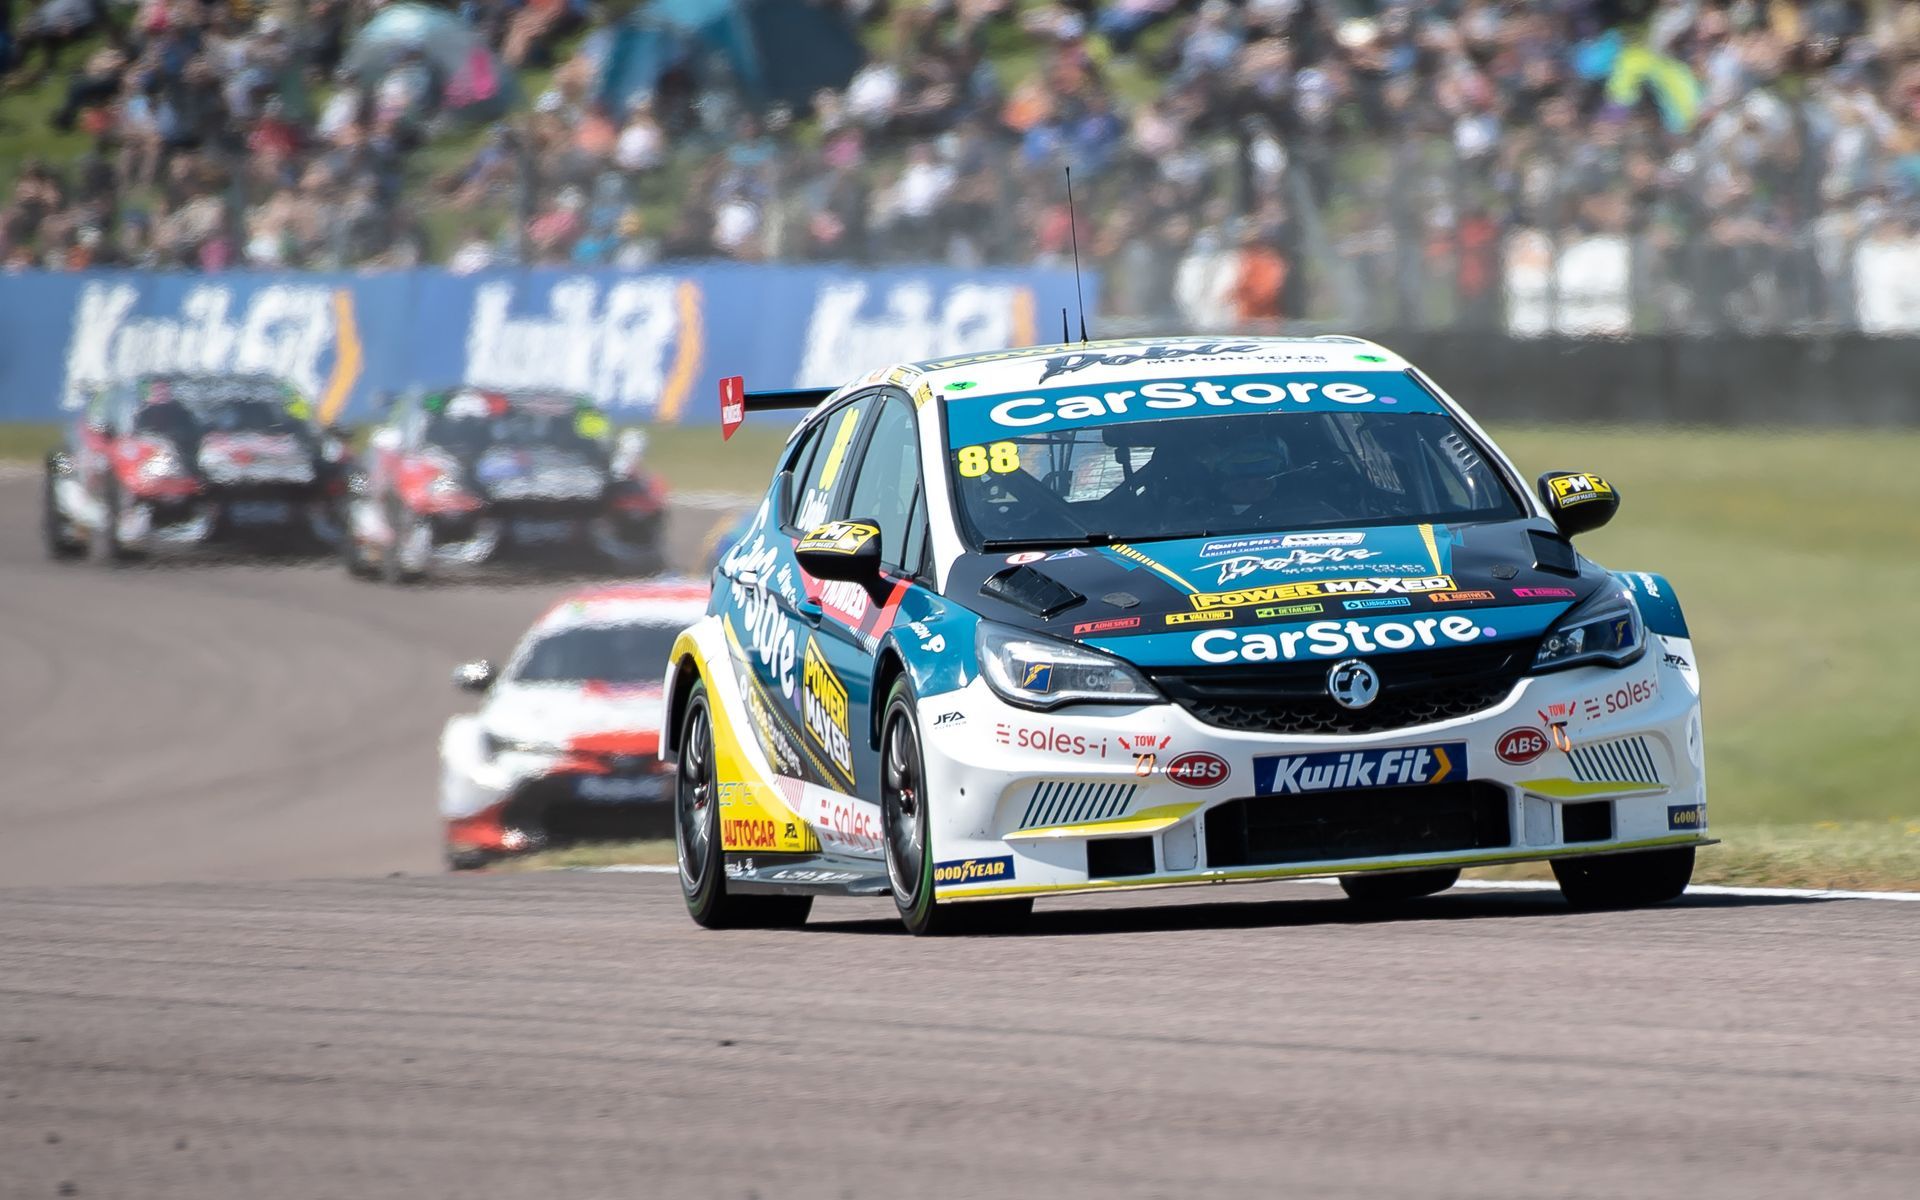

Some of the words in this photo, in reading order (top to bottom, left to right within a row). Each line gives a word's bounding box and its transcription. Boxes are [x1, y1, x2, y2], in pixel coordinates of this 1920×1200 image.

[957, 440, 1021, 478] 88
[1554, 475, 1608, 497] PMR
[806, 521, 870, 541] PMR
[1200, 583, 1322, 607] POWER
[1324, 577, 1449, 594] MAXED
[1362, 598, 1410, 609] LUBRICANTS
[1663, 653, 1689, 666] JFA
[805, 647, 846, 739] POWER
[933, 711, 966, 726] JFA
[1548, 702, 1566, 718] TOW
[805, 686, 851, 772] MAXED
[1018, 726, 1108, 758] sales-i
[1134, 735, 1157, 747] TOW
[1504, 736, 1543, 756] ABS
[1176, 760, 1222, 779] ABS
[724, 819, 777, 848] AUTOCAR
